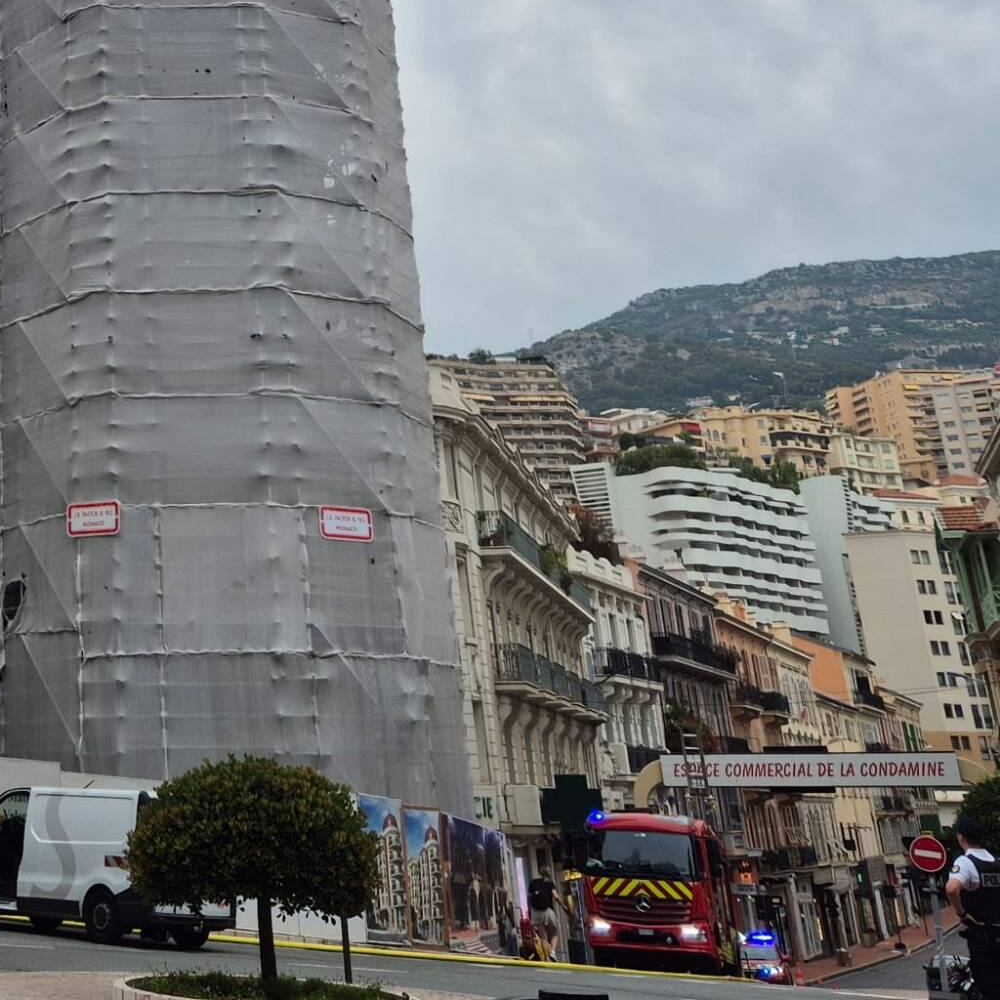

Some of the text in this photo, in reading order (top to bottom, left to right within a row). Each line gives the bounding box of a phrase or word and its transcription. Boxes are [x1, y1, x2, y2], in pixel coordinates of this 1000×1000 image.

[725, 763, 812, 777] COMMERCIAL
[817, 762, 834, 777] DE
[840, 762, 855, 777] LA
[860, 761, 945, 777] CONDAMINE
[983, 874, 1000, 886] POL
